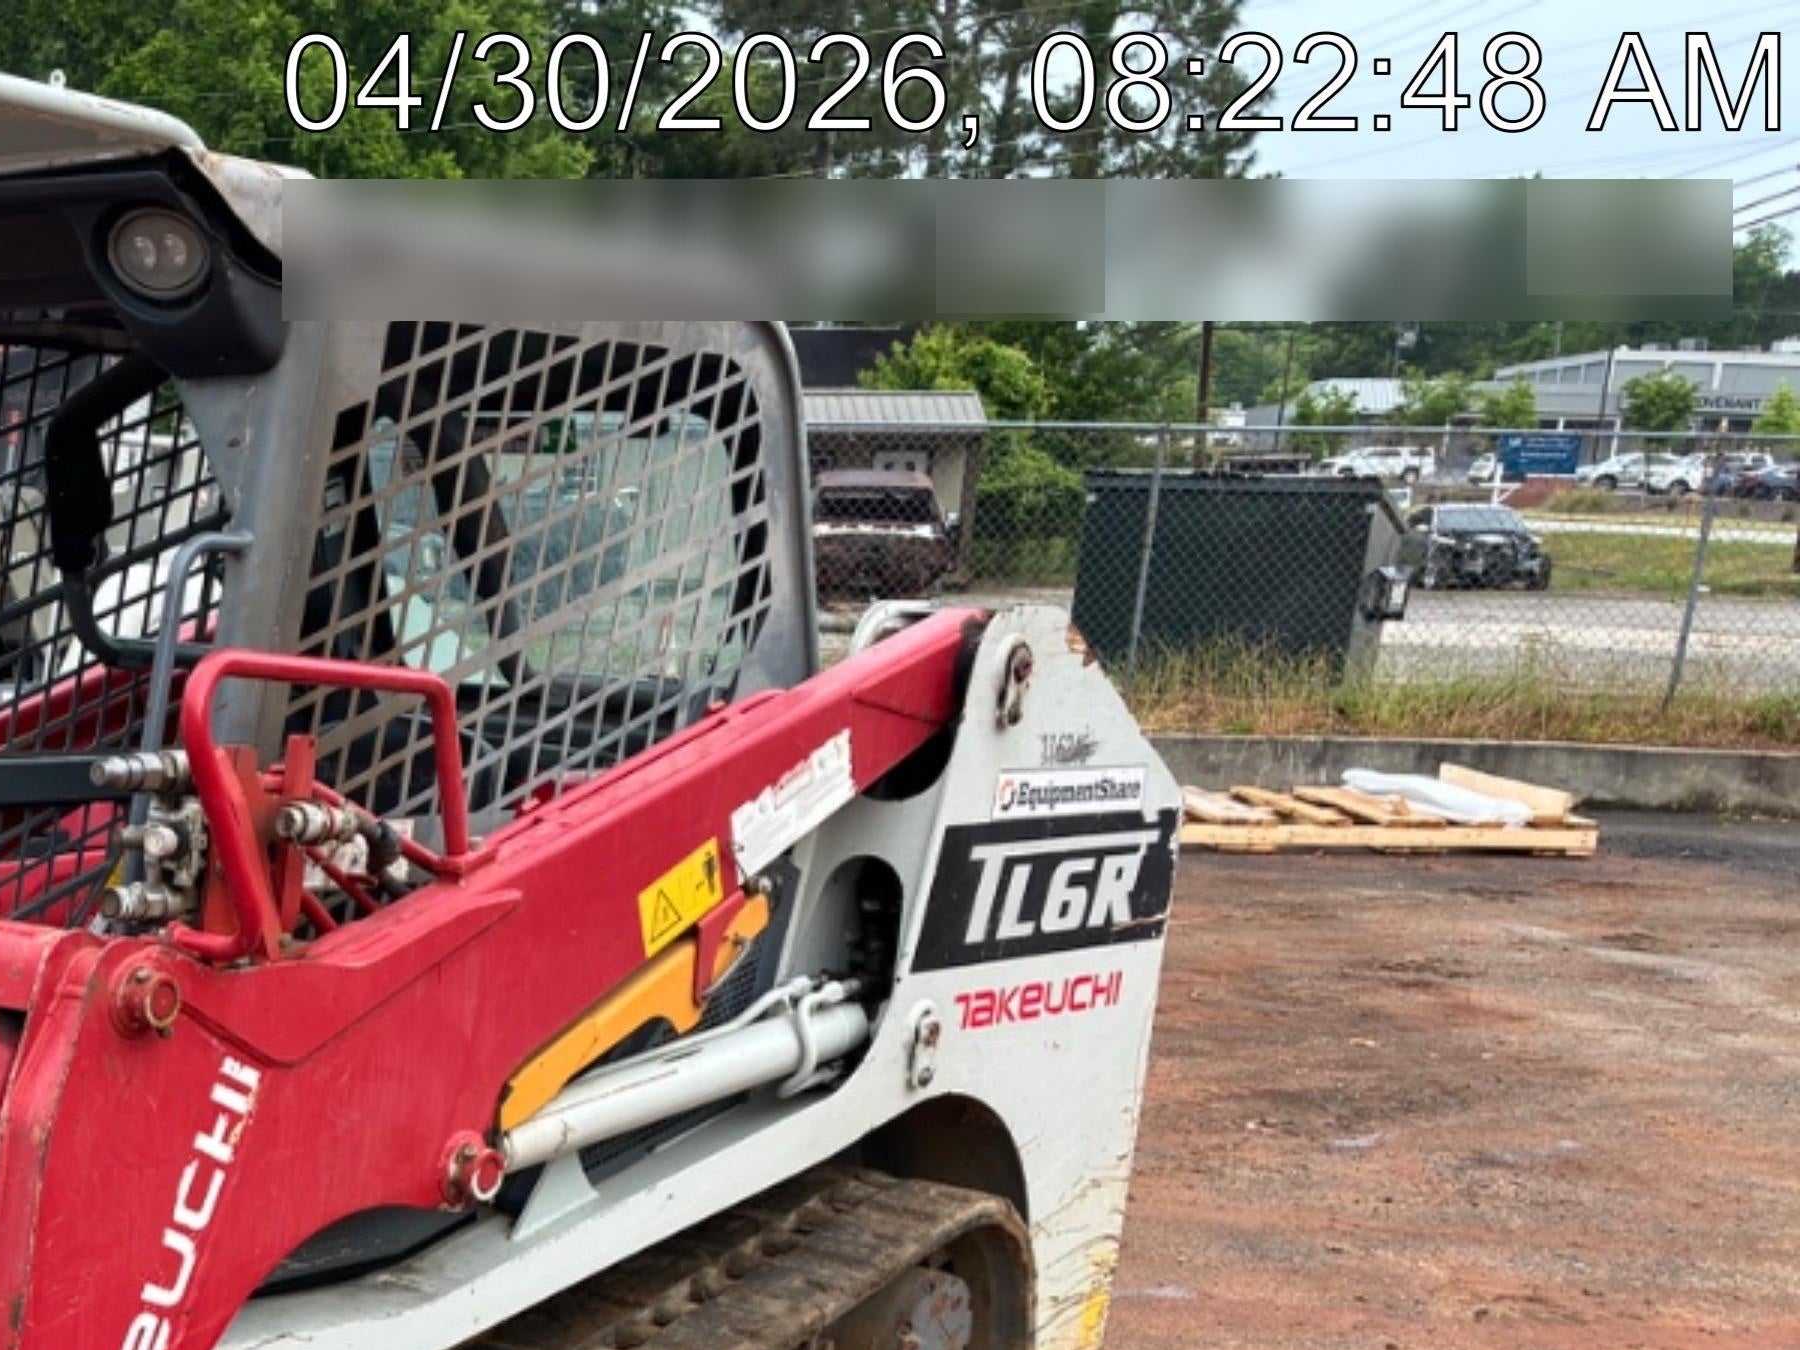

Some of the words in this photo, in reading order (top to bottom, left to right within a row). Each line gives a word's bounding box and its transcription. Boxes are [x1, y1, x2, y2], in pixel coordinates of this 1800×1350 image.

[1017, 778, 1141, 809] EquipmentShare
[964, 829, 1162, 945] TL6R
[953, 970, 1123, 1030] TAKEUCHI
